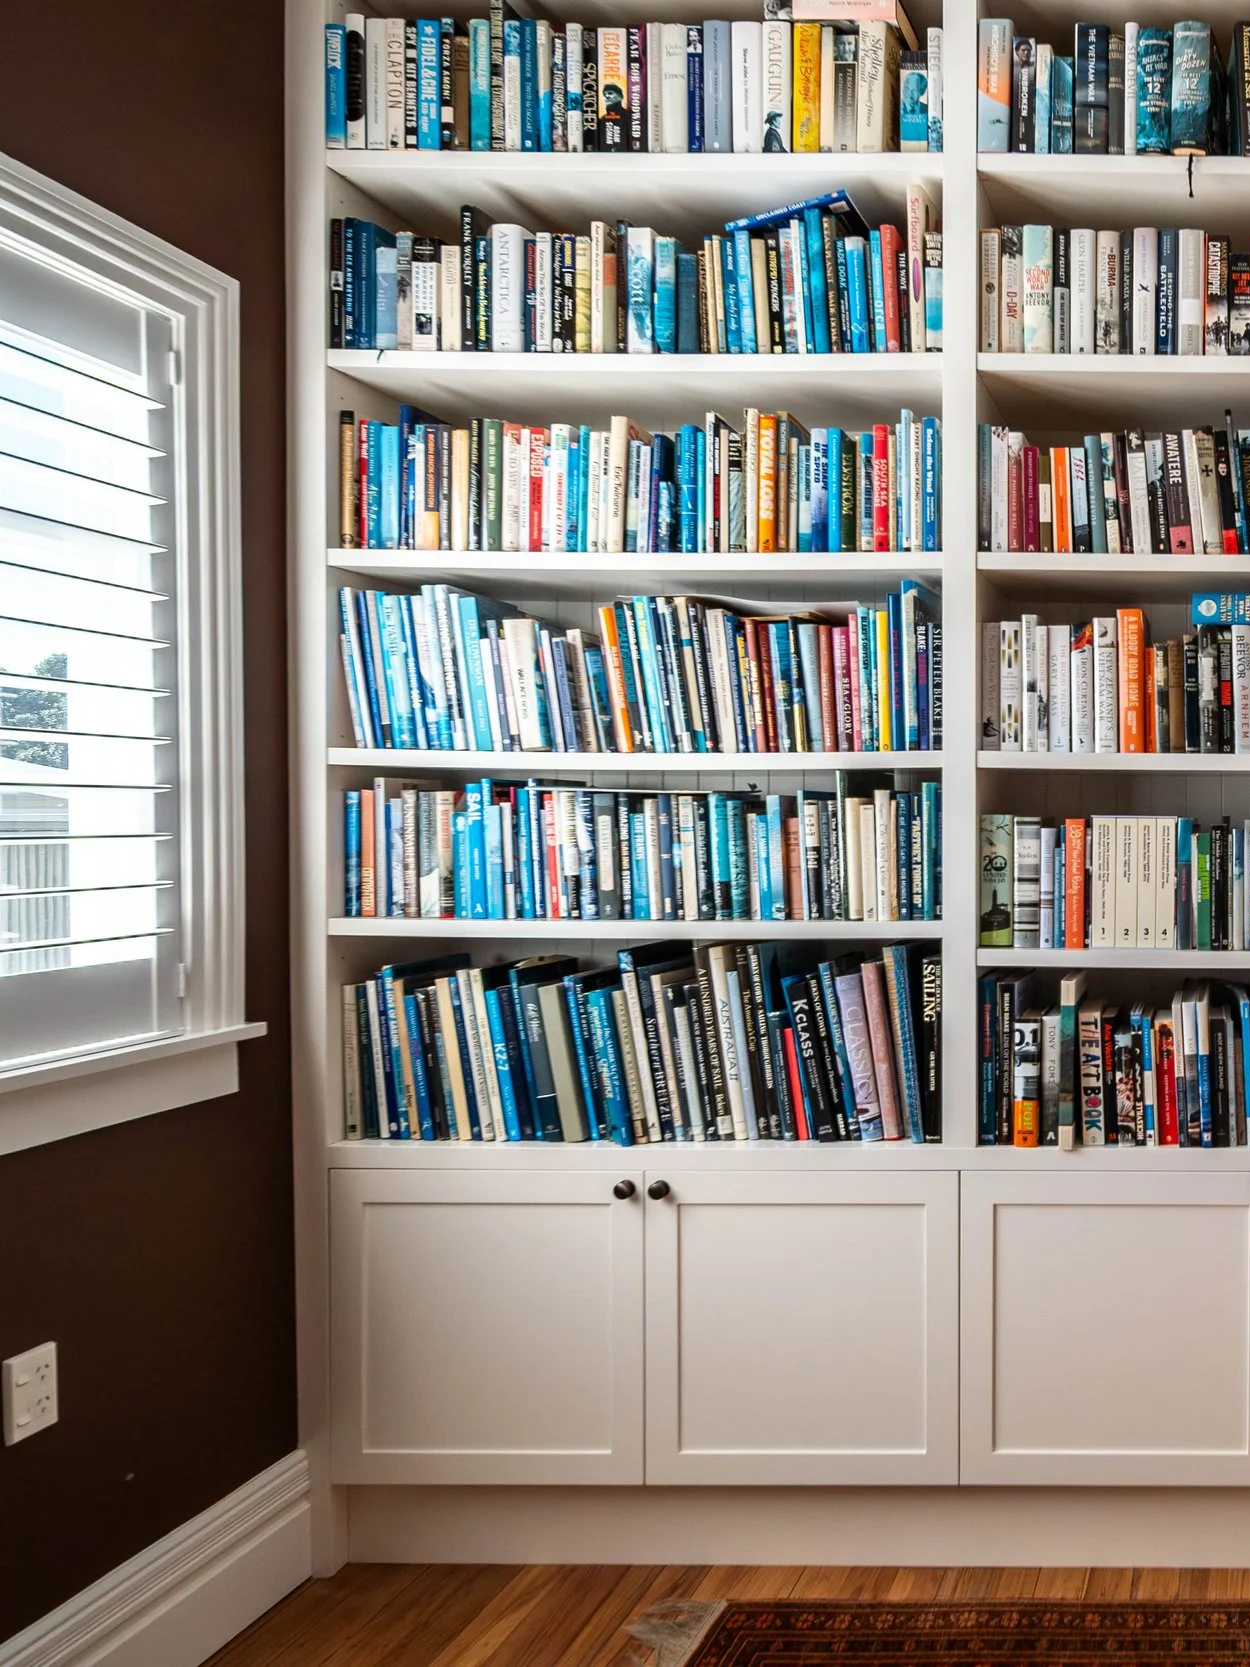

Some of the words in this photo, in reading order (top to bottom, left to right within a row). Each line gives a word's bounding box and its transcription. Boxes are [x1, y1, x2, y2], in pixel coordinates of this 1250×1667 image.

[406, 27, 416, 46] SPY
[630, 28, 639, 58] FEAR
[1087, 28, 1096, 42] THE
[406, 62, 416, 78] KIT
[422, 37, 436, 100] FIDEL&CHE
[630, 63, 640, 82] BOB
[768, 30, 783, 104] GAUGUIN
[1087, 45, 1096, 80] VIETNAM
[1176, 54, 1197, 65] DIRTY
[1182, 60, 1206, 70] DOZEN
[387, 40, 402, 109] CLAPTON
[1148, 83, 1161, 94] 12
[1186, 79, 1198, 89] 12
[406, 81, 417, 128] BENNETTS
[583, 62, 596, 130] SPYCATCHER
[1020, 68, 1028, 116] UNBROKEN
[1087, 82, 1096, 101] WAR
[630, 84, 641, 137] WOODWARD
[463, 212, 472, 242] FRANK
[910, 198, 920, 252] Surfboard
[464, 245, 473, 286] WORSLEY
[837, 241, 846, 264] WADE
[898, 253, 907, 267] THE
[498, 231, 510, 314] ANTARCTICA
[630, 258, 647, 304] Scott
[838, 266, 847, 288] DOAK
[898, 269, 907, 290] WAVE
[1106, 254, 1116, 287] BURMA
[1208, 242, 1221, 295] CATASTROPHE
[875, 301, 886, 330] orca
[1006, 292, 1017, 318] D-DAY
[1158, 265, 1167, 337] BATTLEFIELD
[530, 434, 544, 476] EXPOSED
[760, 428, 774, 476] TOTAL
[814, 442, 821, 452] OF
[1166, 434, 1181, 484] AWATERE
[760, 480, 774, 520] LOSS
[916, 626, 926, 652] BLAKE:
[932, 628, 942, 646] SIR
[1128, 624, 1138, 652] BLOODY
[932, 650, 942, 684] PETER
[1128, 655, 1138, 676] ROAD
[1236, 636, 1246, 680] BEEVOR
[932, 690, 942, 720] BLAKE
[1128, 680, 1138, 706] HOME
[1240, 686, 1248, 738] ARNHEM
[468, 793, 480, 824] SAIL
[620, 806, 629, 840] AMAZING
[620, 842, 629, 869] SAILING
[621, 871, 630, 900] STORIES
[793, 1000, 806, 1011] K
[924, 964, 936, 1022] SAILING
[1001, 993, 1010, 1010] BRIAN
[797, 1014, 812, 1057] CLASS
[1001, 1012, 1010, 1032] BRAKE
[1082, 1017, 1101, 1048] THE
[1001, 1034, 1010, 1049] LENS
[1001, 1051, 1010, 1060] ON
[496, 1044, 508, 1072] KZ-7
[645, 1018, 660, 1070] Southern
[656, 1072, 671, 1122] BREEZE
[1001, 1062, 1010, 1071] THE
[1082, 1054, 1101, 1082] ART
[1002, 1072, 1010, 1094] WORLD
[1022, 1103, 1034, 1130] POP
[1082, 1087, 1102, 1132] BOOK
